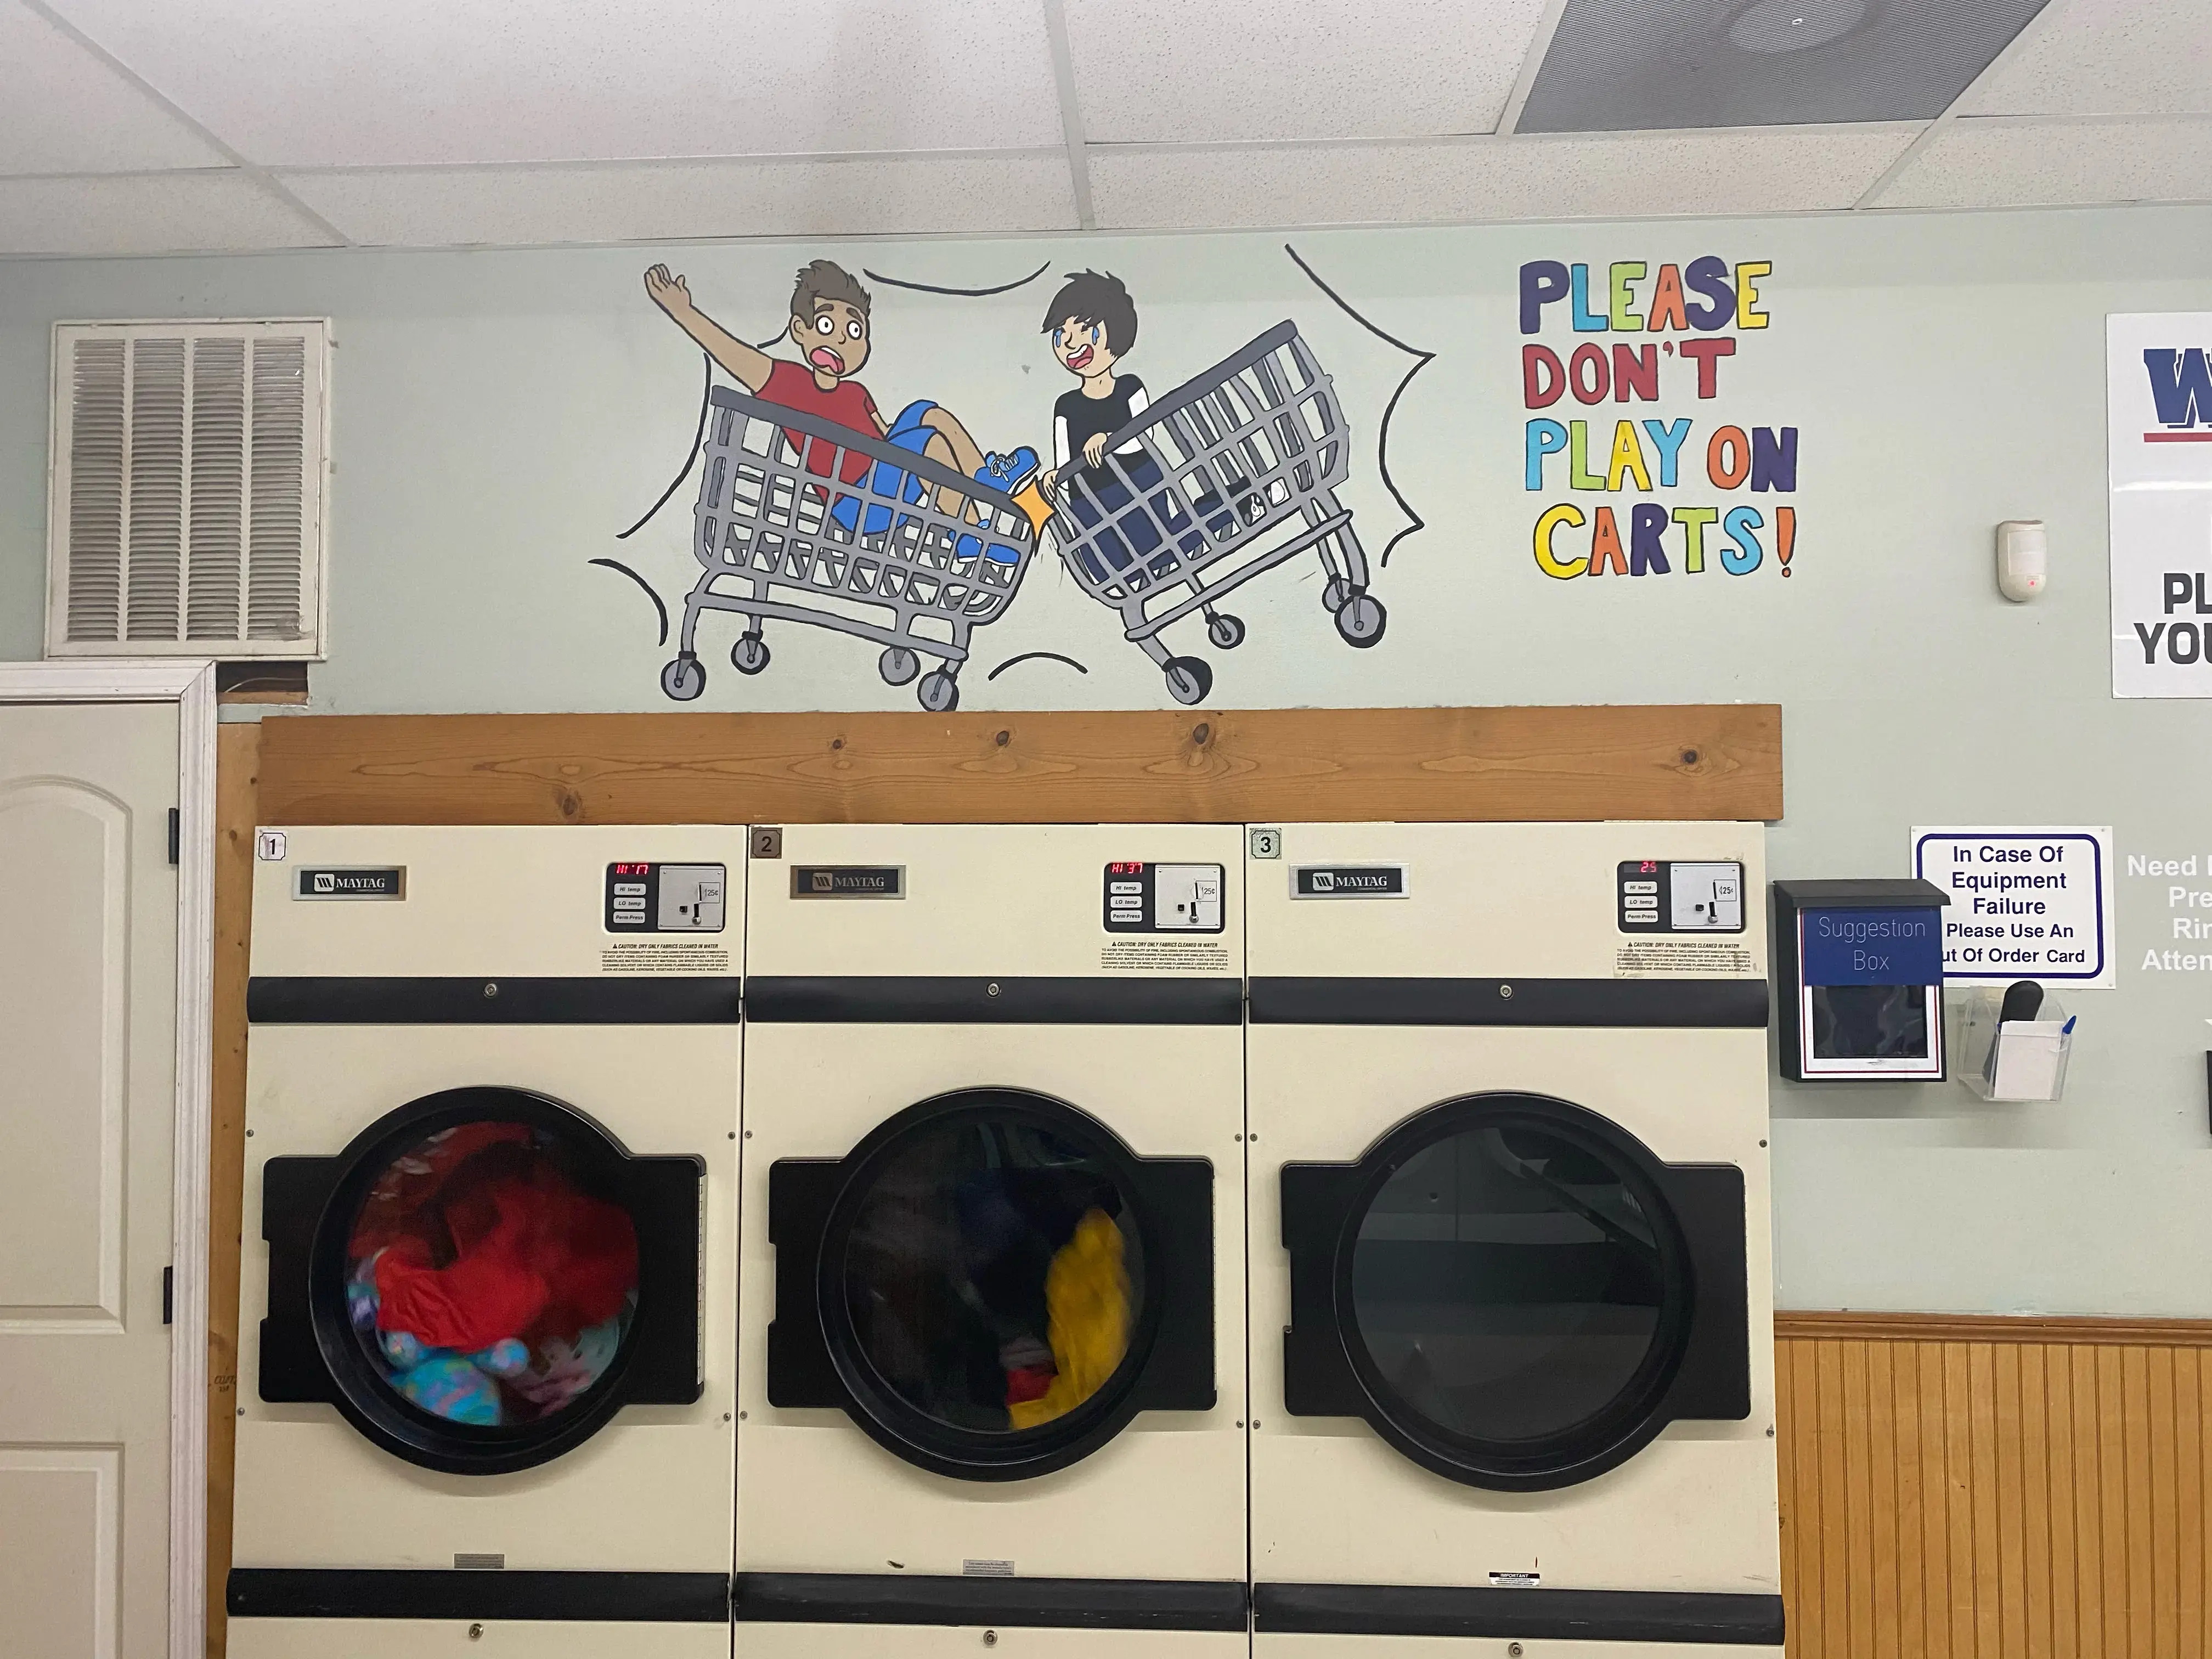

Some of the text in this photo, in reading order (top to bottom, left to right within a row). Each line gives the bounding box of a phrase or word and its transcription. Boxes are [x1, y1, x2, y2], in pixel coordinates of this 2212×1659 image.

[1519, 255, 1773, 335] PLEASE
[1522, 336, 1736, 409] DON'T
[1525, 417, 1798, 493] PLAY ON
[1532, 503, 1797, 580] CARTS!
[270, 838, 276, 855] 1
[761, 836, 772, 852] 2
[1260, 836, 1271, 853] 3
[1953, 845, 2064, 863] In Case Of
[1640, 861, 1657, 873] 25
[2127, 854, 2197, 876] Need
[336, 878, 385, 888] MAYTAG
[835, 877, 884, 887] MAYTAG
[1335, 876, 1387, 887] MAYTAG
[1951, 871, 2067, 893] Equipment
[1973, 898, 2046, 915] Failure
[1819, 916, 1926, 943] Suggestion
[1946, 923, 2074, 938] Please Use An
[1854, 950, 1889, 970] Box
[1942, 948, 2085, 962] ut Of Order Card
